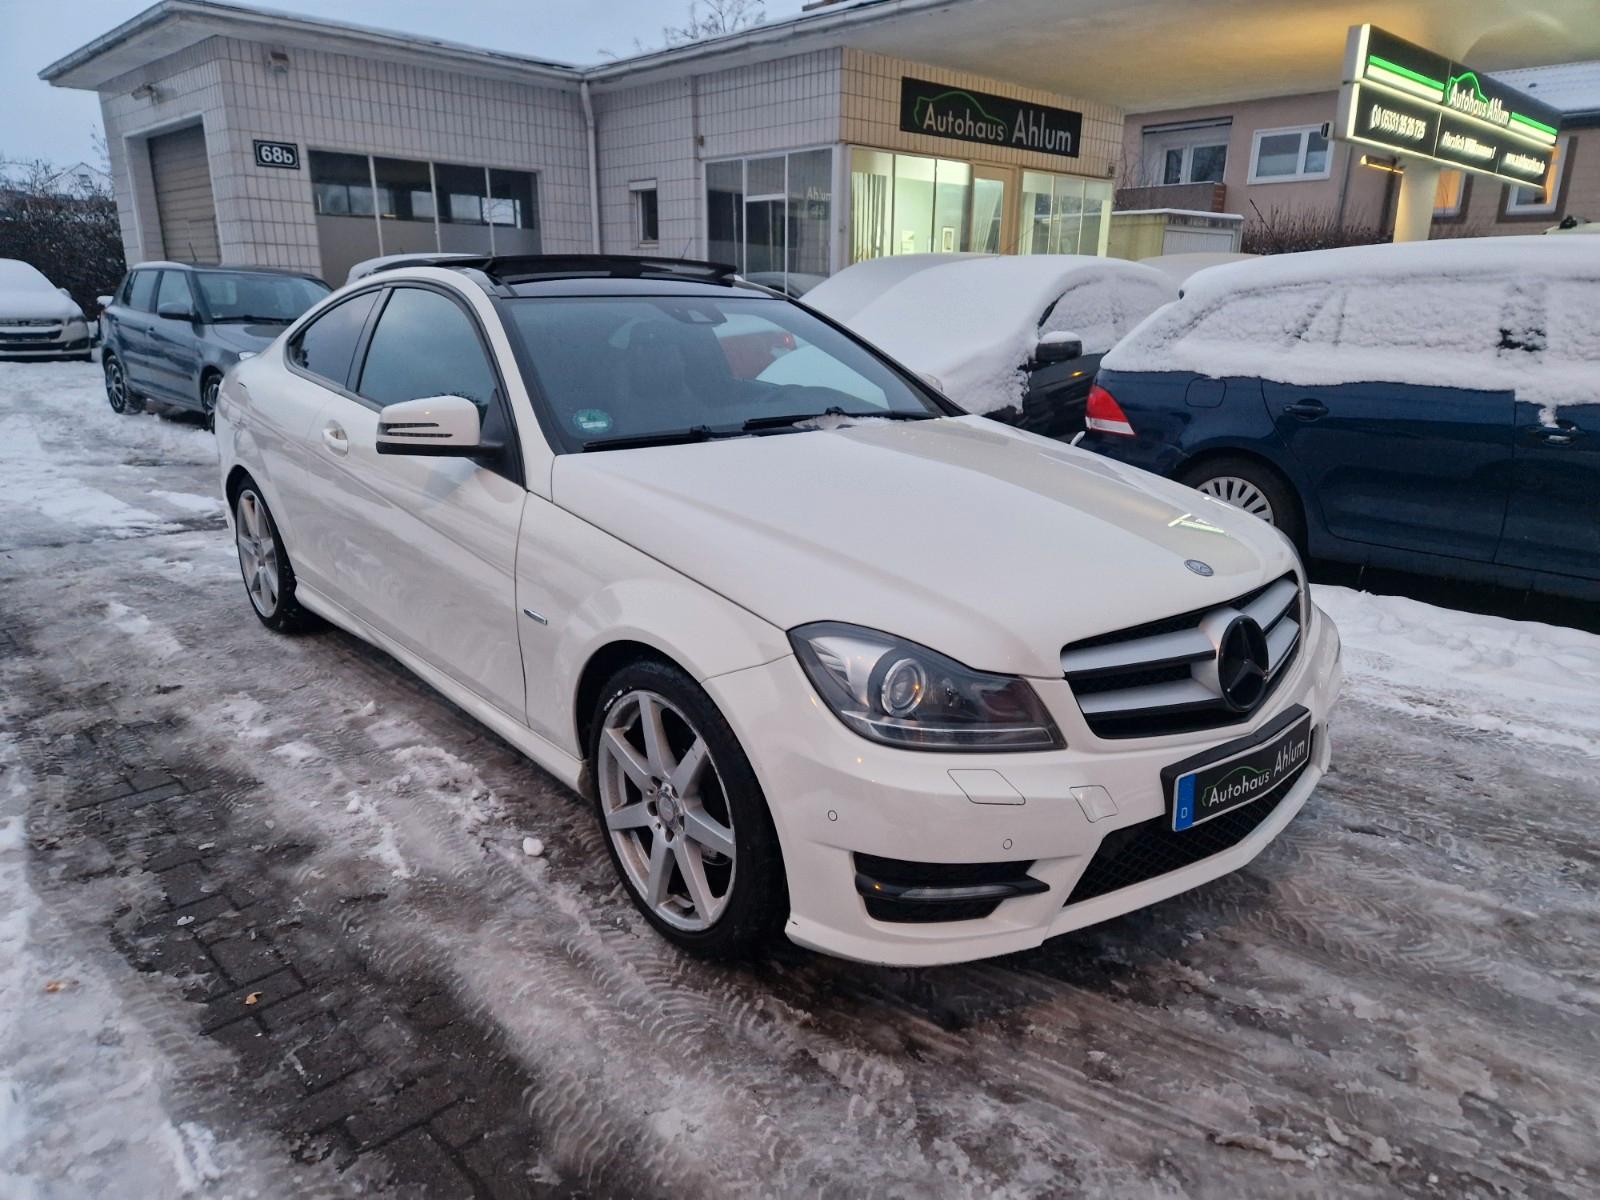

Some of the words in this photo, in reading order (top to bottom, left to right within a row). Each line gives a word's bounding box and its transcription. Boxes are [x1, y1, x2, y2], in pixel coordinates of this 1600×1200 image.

[1450, 82, 1488, 118] Autohaus
[1486, 97, 1509, 125] Ahlum
[923, 103, 1004, 141] Autohaus
[1012, 108, 1071, 152] Ahlum
[261, 146, 294, 164] 68b
[1208, 770, 1270, 808] Autohaus
[1273, 739, 1305, 777] Ahlum
[1180, 807, 1188, 819] D
